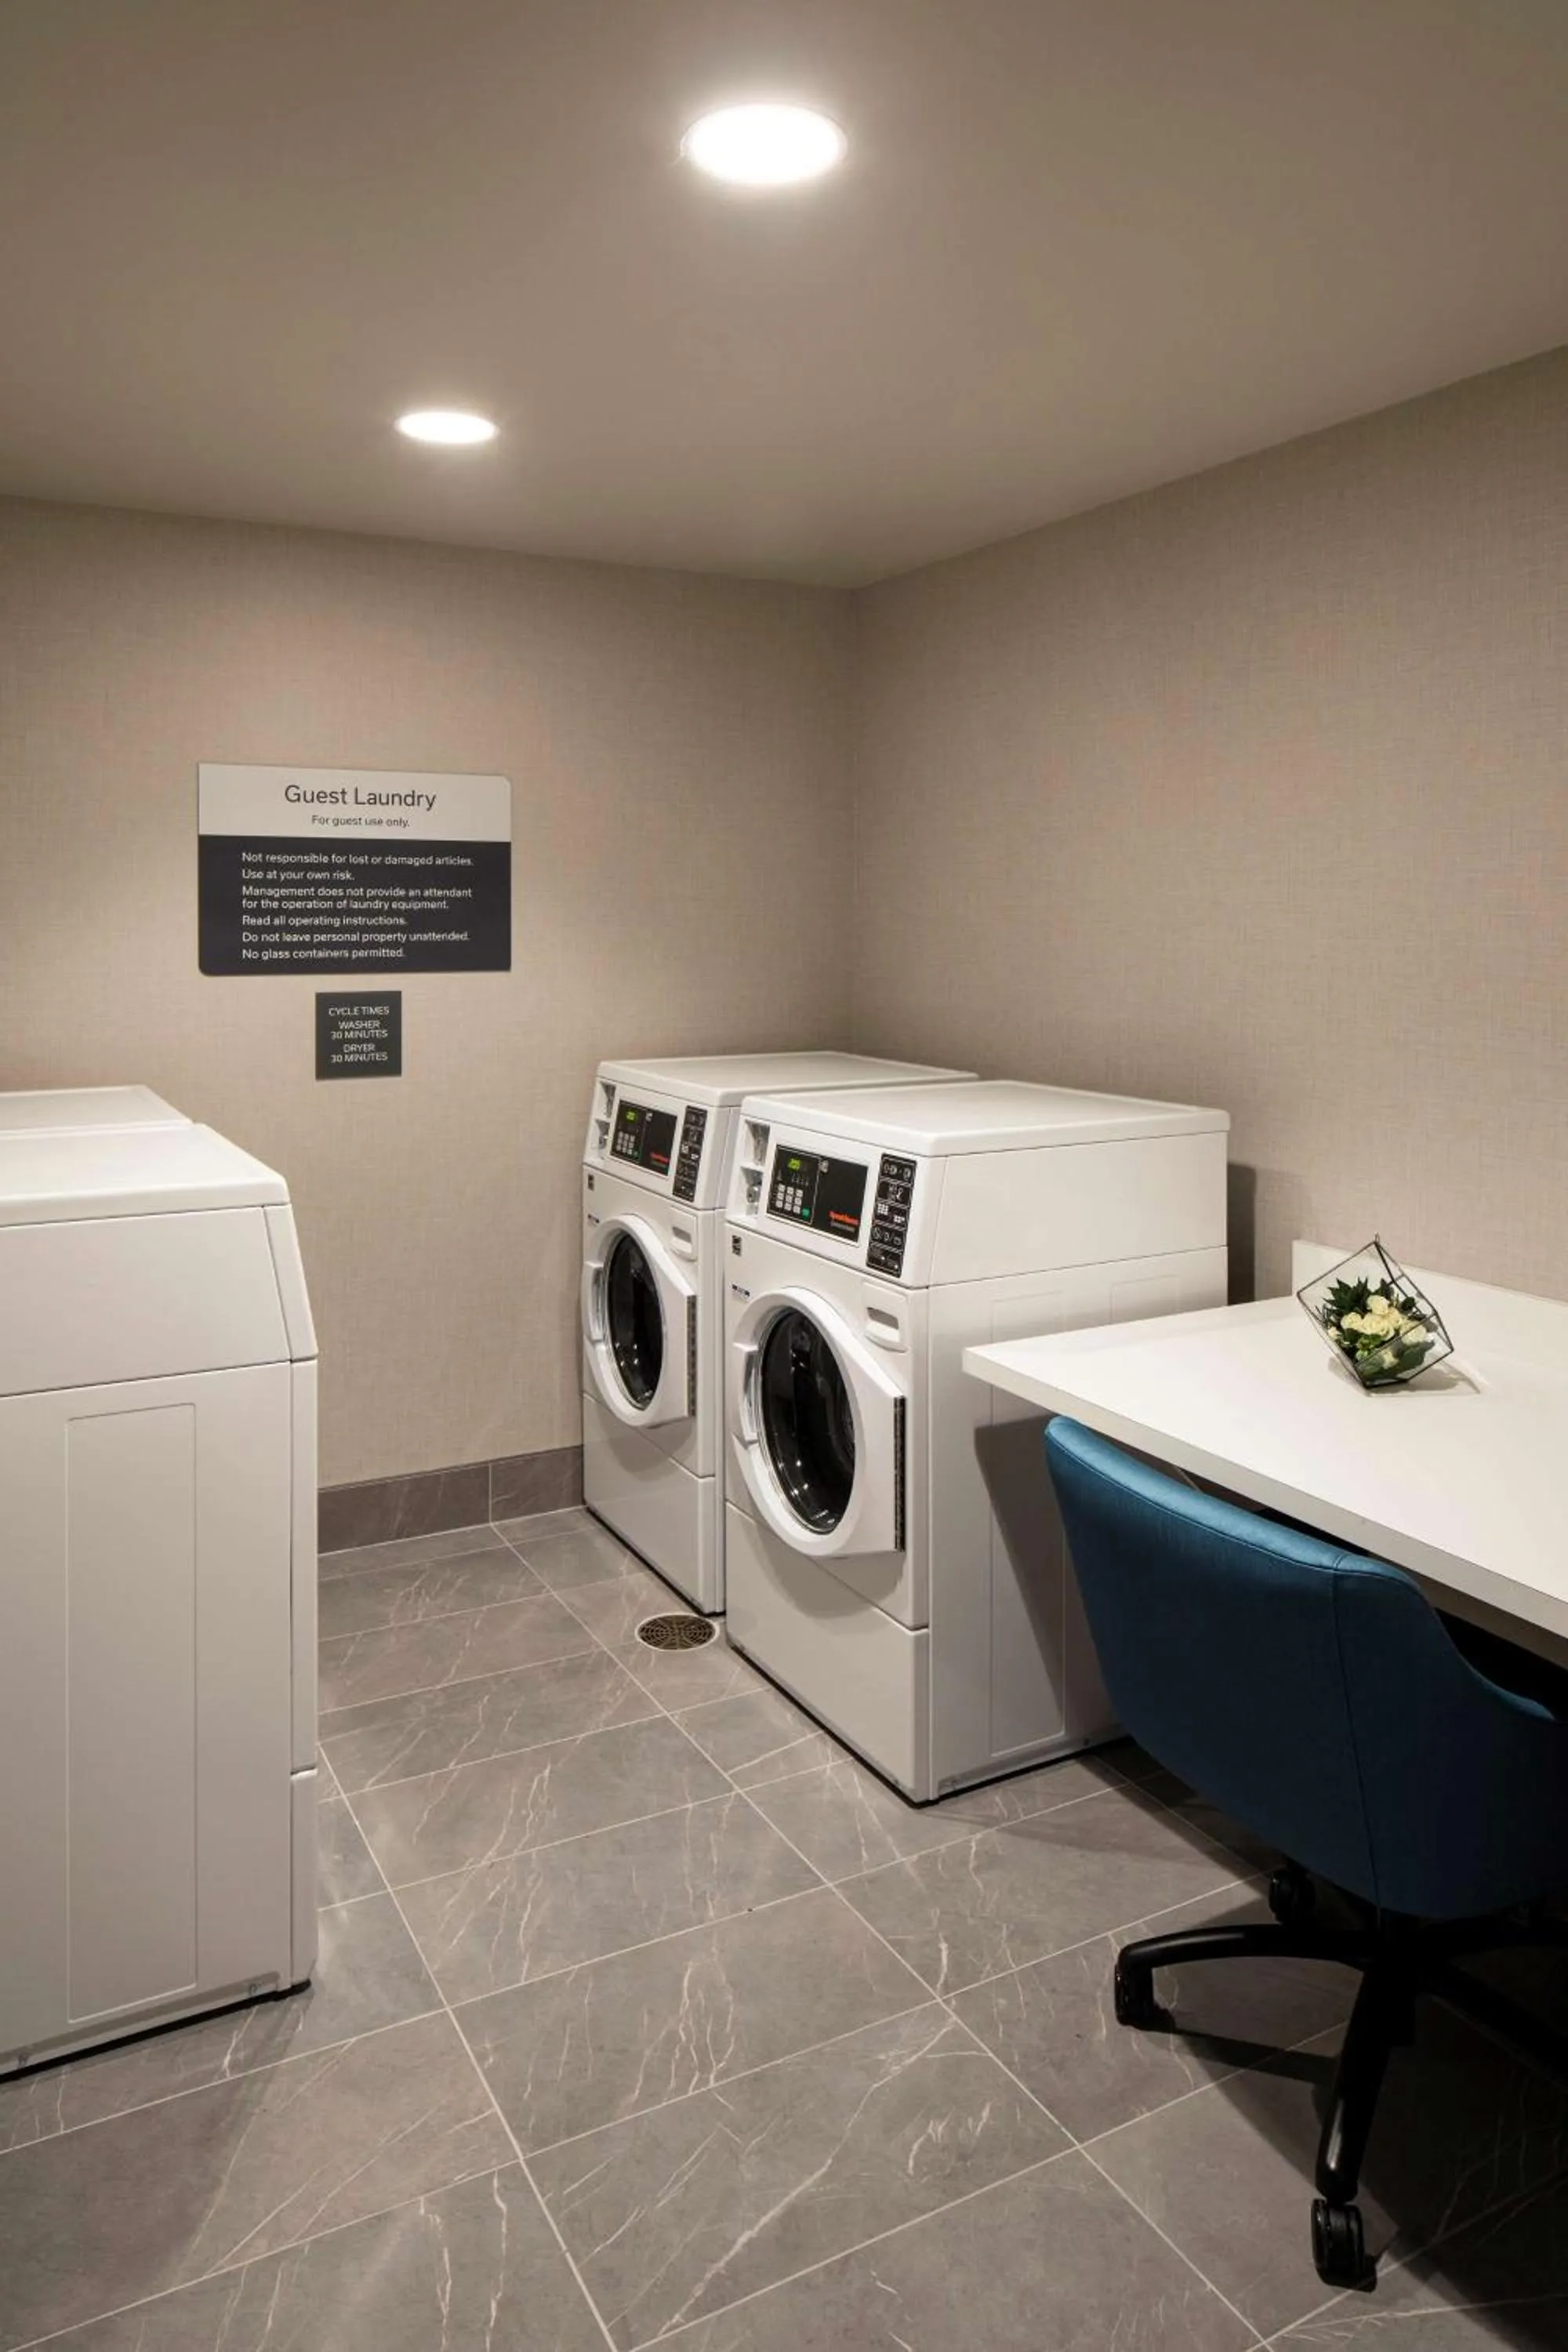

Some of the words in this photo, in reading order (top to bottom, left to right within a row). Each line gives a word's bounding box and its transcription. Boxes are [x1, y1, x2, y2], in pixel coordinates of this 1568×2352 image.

[285, 785, 348, 804] Guest
[354, 786, 437, 811] Laundry
[312, 815, 329, 826] For
[332, 816, 362, 827] guest
[386, 818, 410, 829] only.
[241, 852, 263, 862] Not
[266, 852, 329, 864] responsible
[331, 853, 347, 863] for
[349, 854, 368, 864] lost
[371, 855, 382, 864] or
[385, 855, 434, 866] damaged
[242, 869, 264, 879] Use
[266, 869, 278, 879] at
[280, 870, 303, 881] your
[332, 869, 355, 880] risk.
[242, 885, 314, 898] Management
[317, 887, 343, 896] does
[346, 887, 364, 896] not
[366, 887, 406, 898] provide
[423, 887, 472, 897] attendant
[241, 898, 258, 909] for
[261, 898, 279, 909] the
[281, 899, 333, 910] operation
[336, 899, 347, 909] of
[349, 899, 390, 910] laundry
[391, 899, 449, 910] equipment.
[242, 915, 270, 925] Read
[273, 915, 286, 925] all
[288, 915, 340, 927] operating
[242, 931, 259, 942] Do
[261, 932, 280, 942] not
[282, 931, 311, 942] leave
[313, 931, 360, 942] personal
[361, 932, 407, 943] property
[242, 948, 260, 959] No
[261, 948, 291, 960] glass
[292, 948, 349, 959] containers
[328, 1007, 359, 1016] CYCLE
[361, 1006, 390, 1015] TIMES
[338, 1020, 381, 1029] WASHER
[344, 1029, 389, 1039] MINUTES
[343, 1044, 376, 1053] DRYER
[344, 1052, 389, 1062] MINUTES
